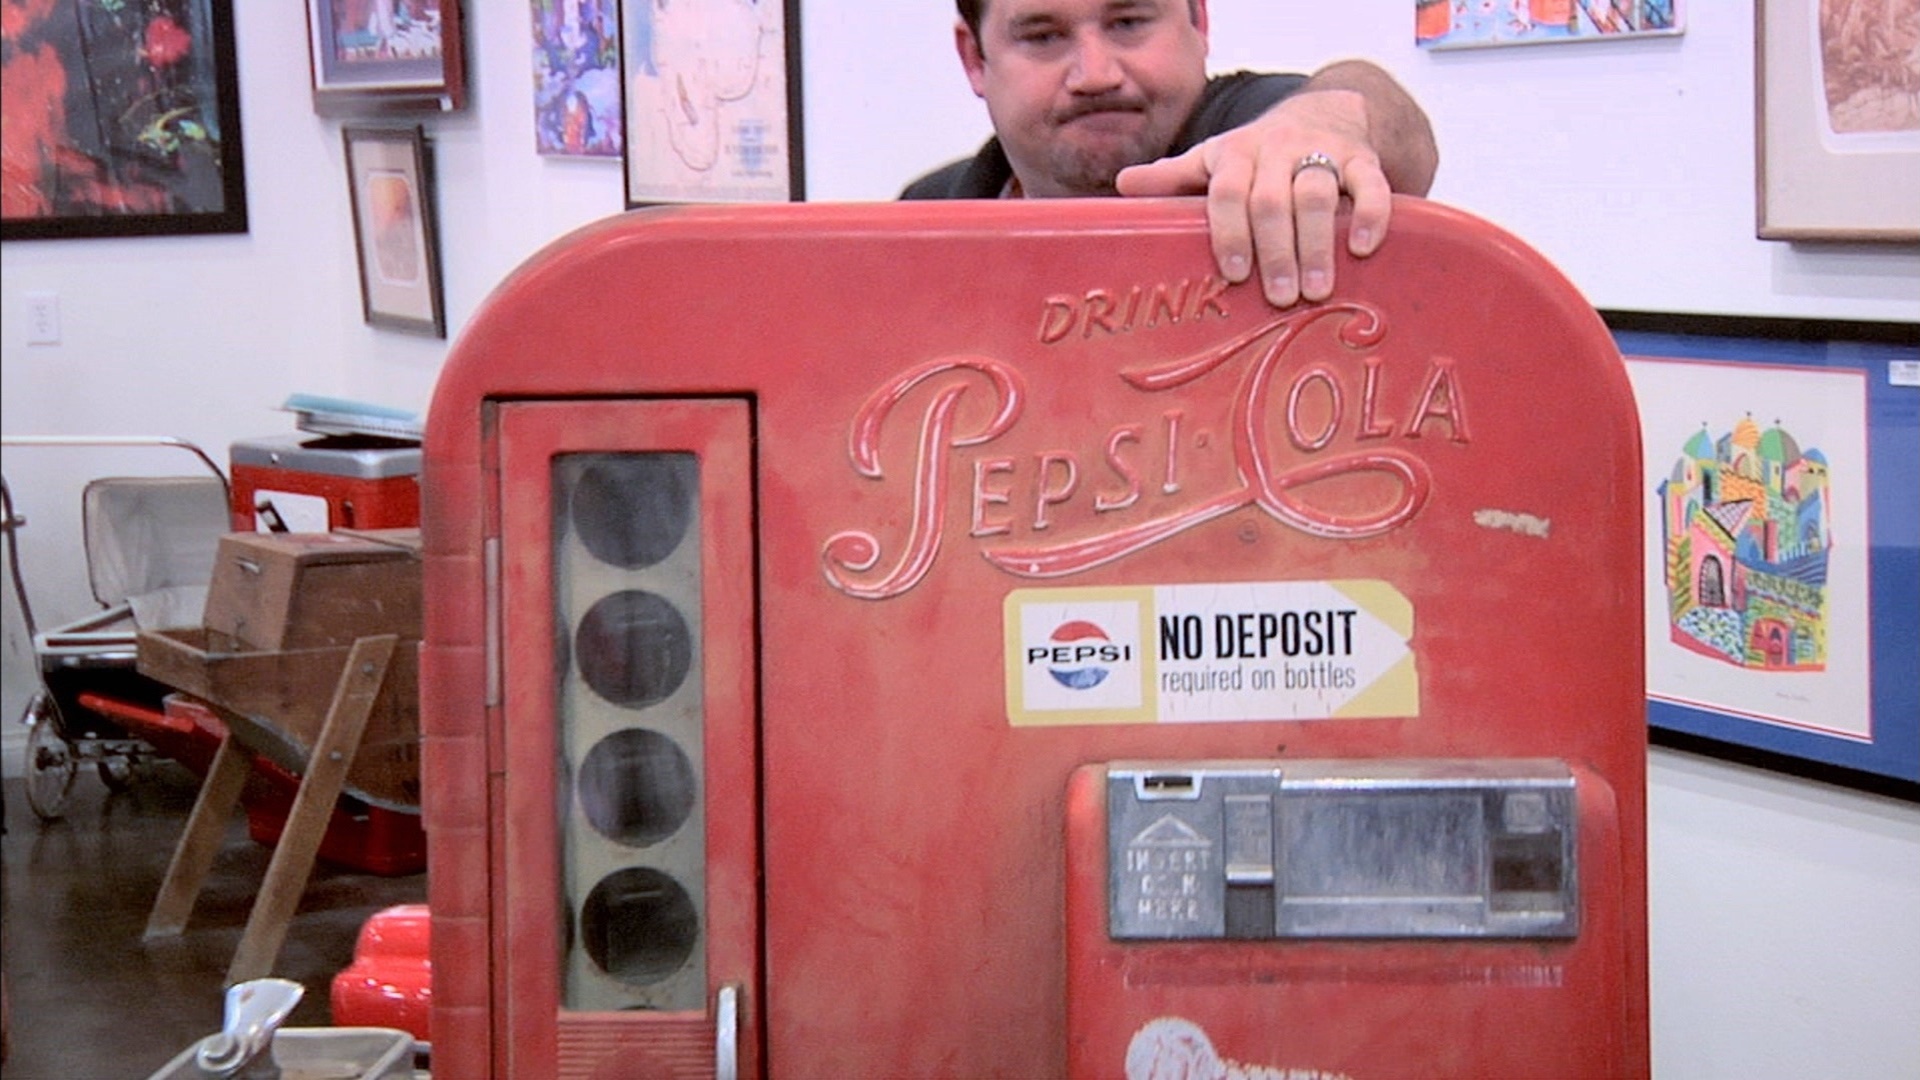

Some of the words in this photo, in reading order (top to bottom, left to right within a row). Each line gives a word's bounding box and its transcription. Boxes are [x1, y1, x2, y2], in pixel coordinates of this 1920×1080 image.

[1039, 275, 1230, 344] DRINK
[1027, 644, 1132, 665] PEPSI
[1160, 614, 1202, 661] NO
[1214, 609, 1357, 660] DEPOSIT
[1161, 664, 1243, 697] required
[1250, 668, 1276, 691] on
[1284, 662, 1356, 691] bottles
